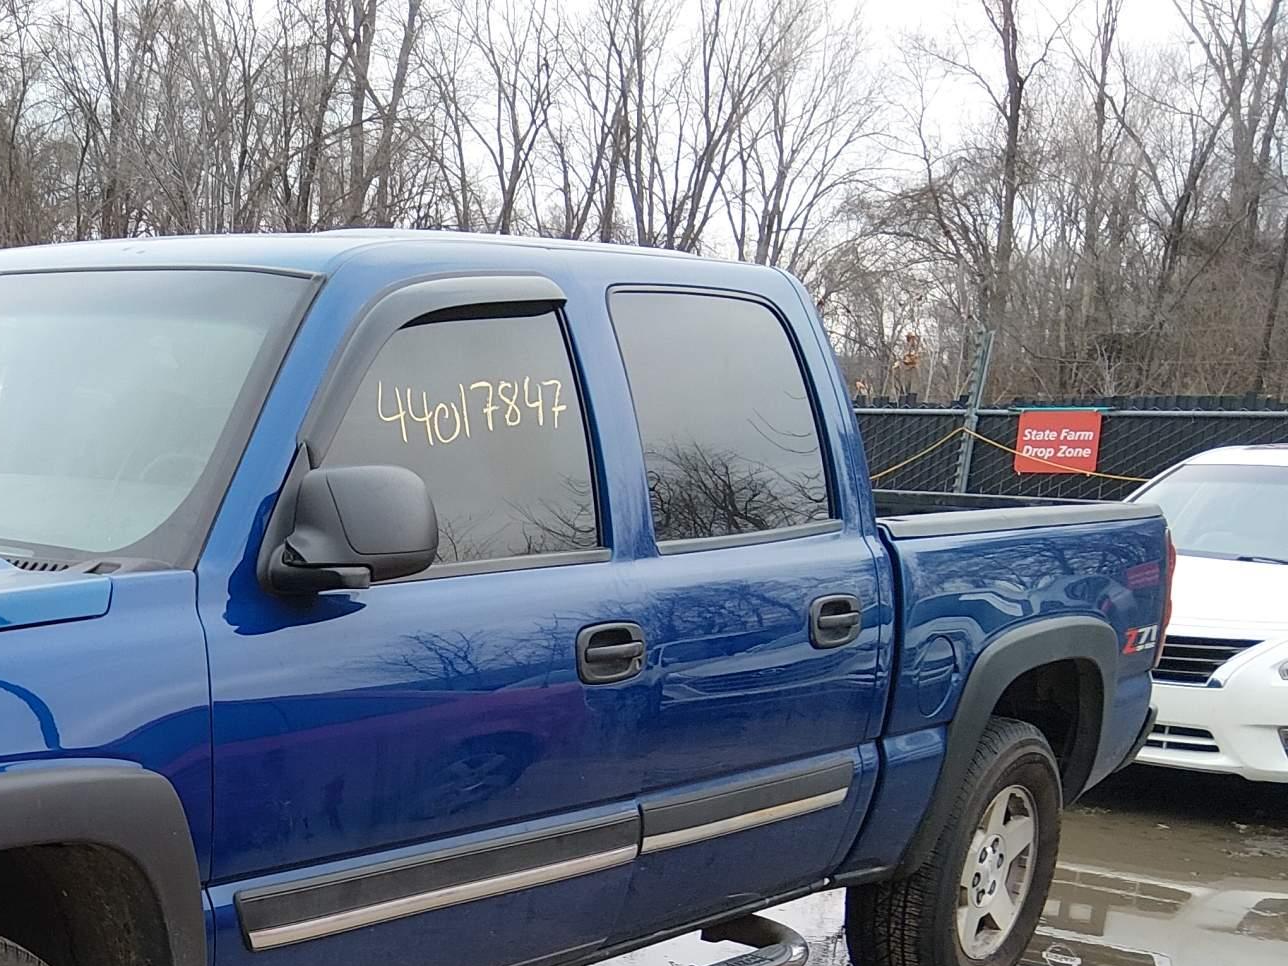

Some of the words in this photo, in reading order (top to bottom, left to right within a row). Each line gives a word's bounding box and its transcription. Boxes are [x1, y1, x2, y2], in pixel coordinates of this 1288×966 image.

[377, 376, 567, 446] 44017847
[1022, 428, 1058, 441] State
[1059, 428, 1095, 441] Farm
[1022, 445, 1055, 460] Drop
[1056, 445, 1092, 458] Zone
[1122, 624, 1158, 655] Z71
